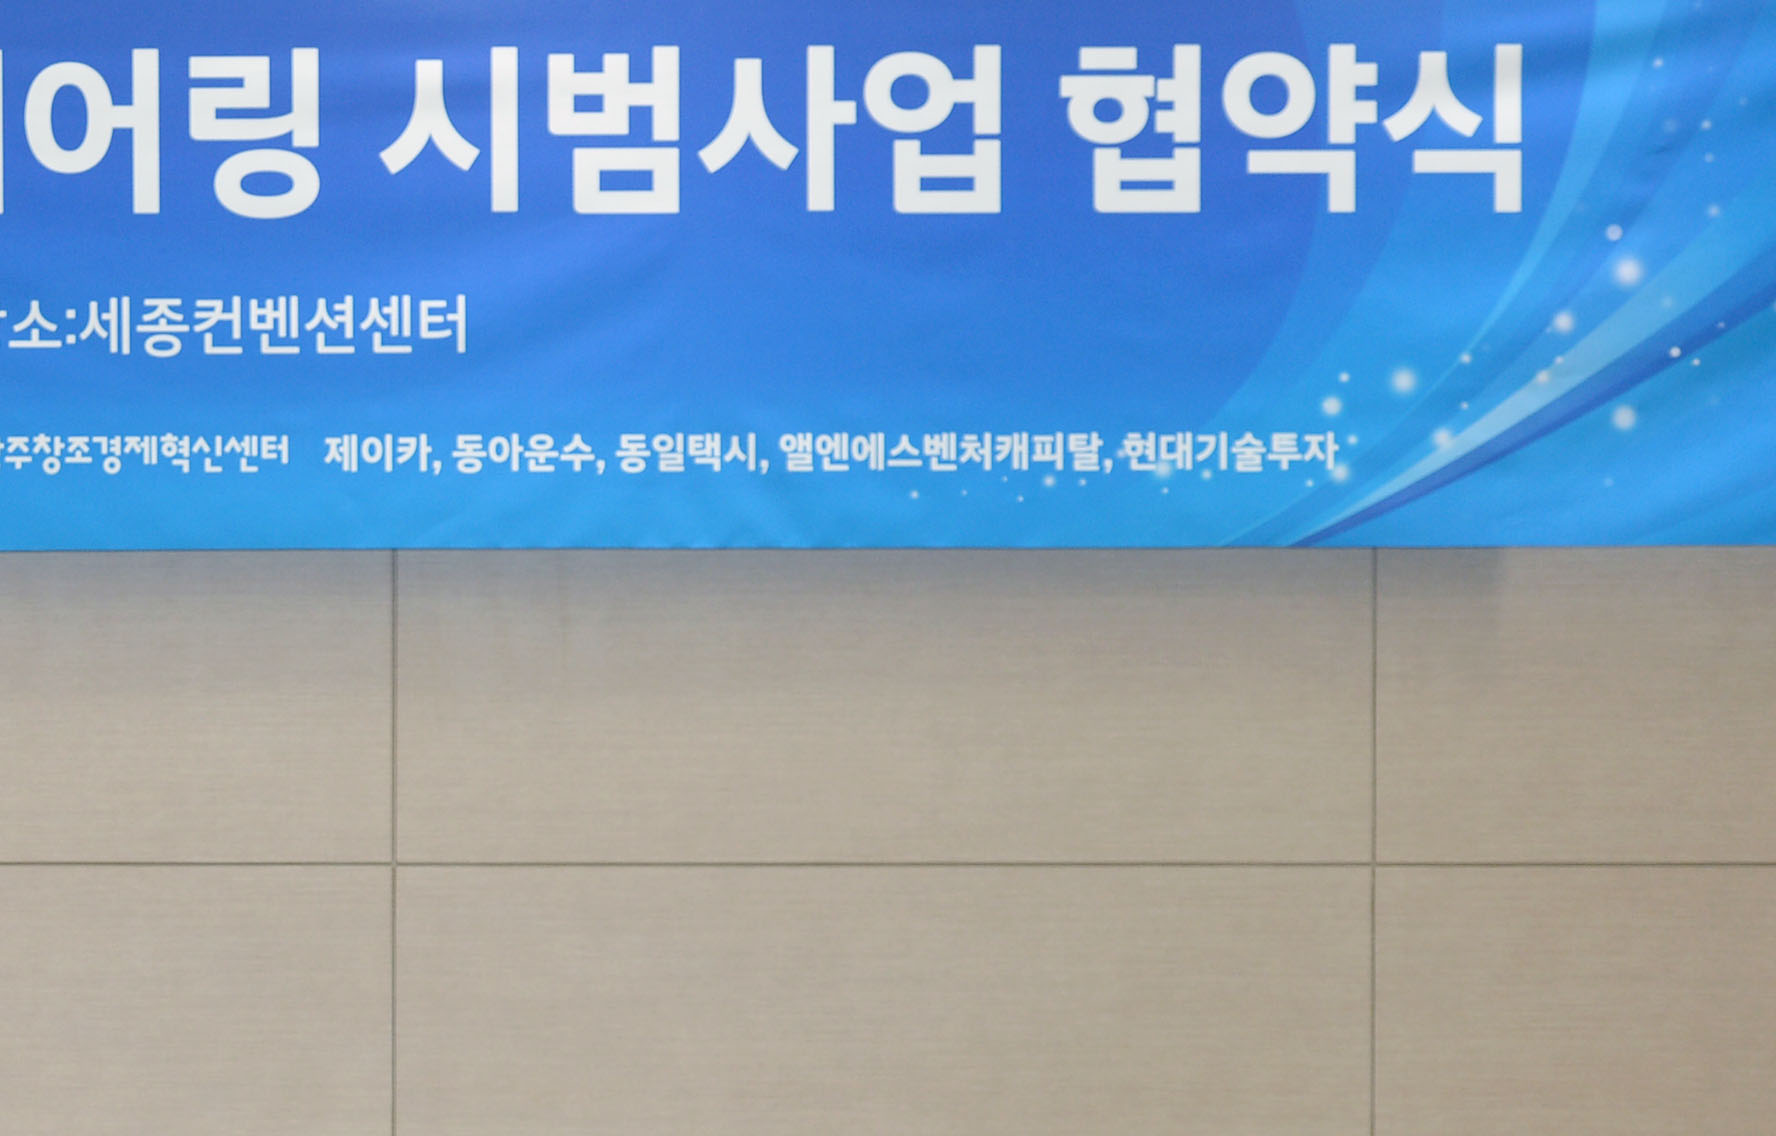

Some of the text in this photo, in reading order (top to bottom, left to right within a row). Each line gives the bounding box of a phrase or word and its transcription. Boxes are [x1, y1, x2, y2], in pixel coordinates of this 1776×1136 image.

[380, 45, 1000, 214] 시범사업
[1060, 44, 1522, 212] 협약식
[325, 434, 441, 474] 제이카,
[453, 434, 605, 474] 동아운수,
[616, 433, 768, 473] 동일택시,
[1122, 432, 1339, 471] 현대기술투자
